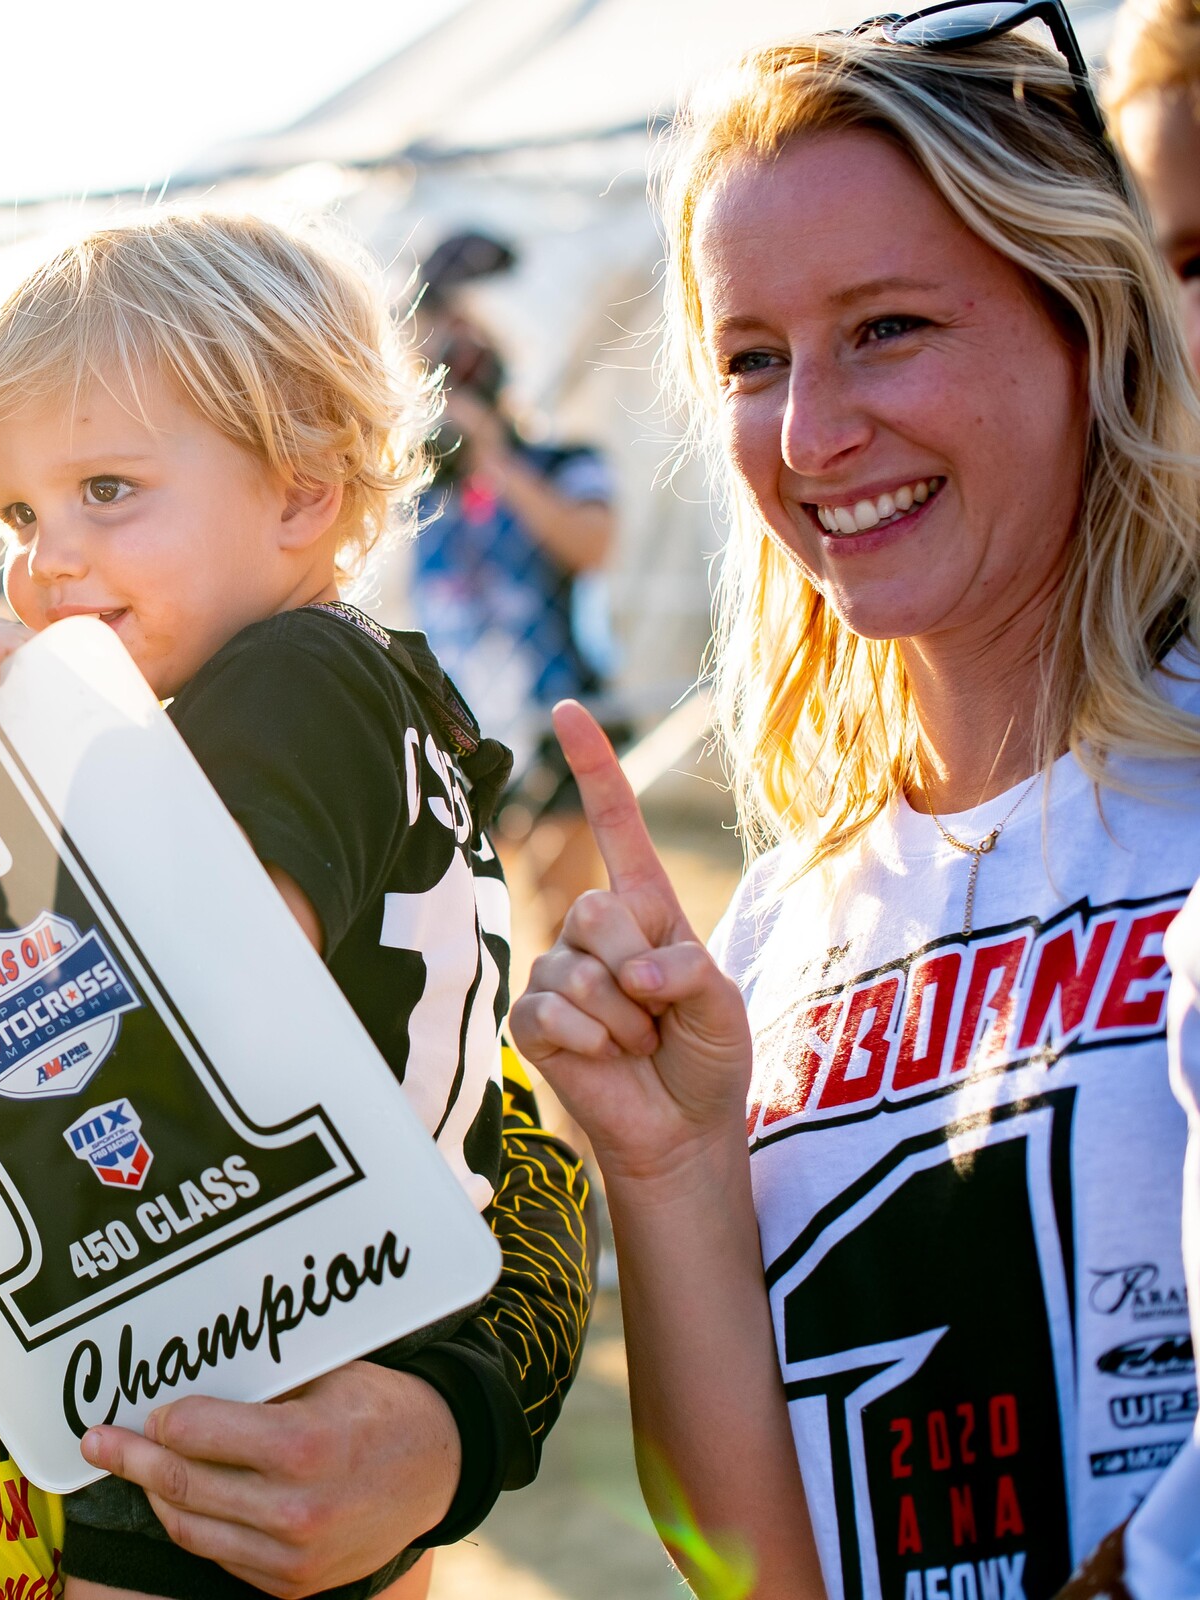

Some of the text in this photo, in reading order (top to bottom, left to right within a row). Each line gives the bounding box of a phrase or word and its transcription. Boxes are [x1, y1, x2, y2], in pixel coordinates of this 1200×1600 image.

[0, 985, 44, 1017] PRO
[748, 909, 1182, 1138] SBORNE
[36, 1053, 72, 1087] AMA
[70, 1102, 132, 1151] MX
[91, 1133, 136, 1162] PRO RACING
[69, 1155, 260, 1279] 450 CLASS
[63, 1230, 410, 1440] Champion
[890, 1393, 1019, 1479] 2020
[898, 1475, 1024, 1556] AMA
